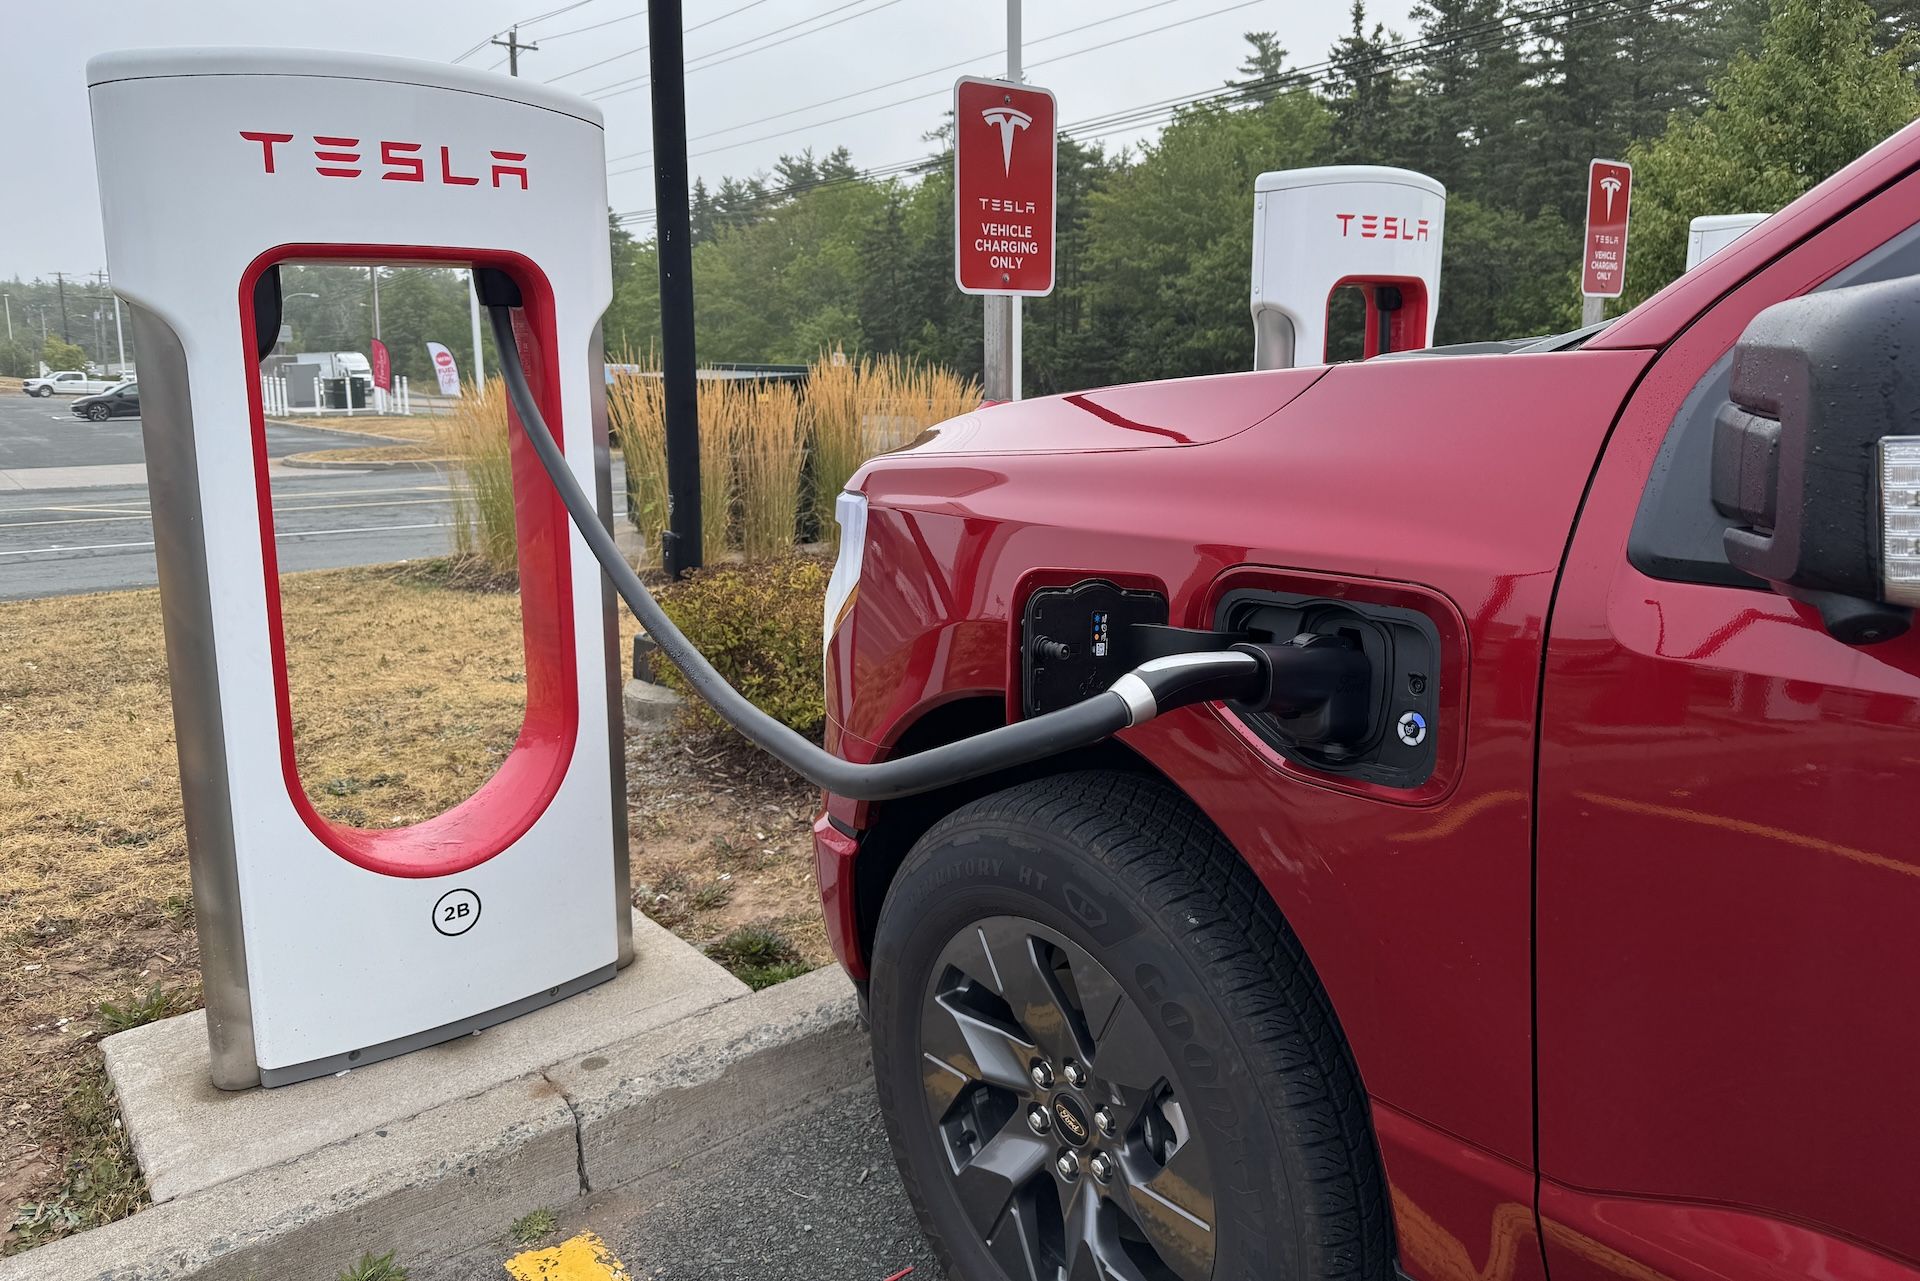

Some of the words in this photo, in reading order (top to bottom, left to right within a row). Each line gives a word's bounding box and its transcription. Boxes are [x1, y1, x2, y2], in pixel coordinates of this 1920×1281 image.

[239, 130, 529, 190] TESLA
[978, 197, 1035, 214] TESLA
[981, 222, 1032, 239] VEHICLE
[1336, 213, 1429, 242] TESLA
[975, 238, 1038, 254] CHARGING
[1595, 234, 1619, 245] TESLA
[990, 255, 1024, 269] ONLY
[1594, 251, 1617, 260] VEHICLE
[1591, 261, 1618, 270] CHARGING
[1596, 271, 1612, 281] ONLY
[444, 902, 470, 922] 2B
[1060, 1109, 1080, 1132] Ford
